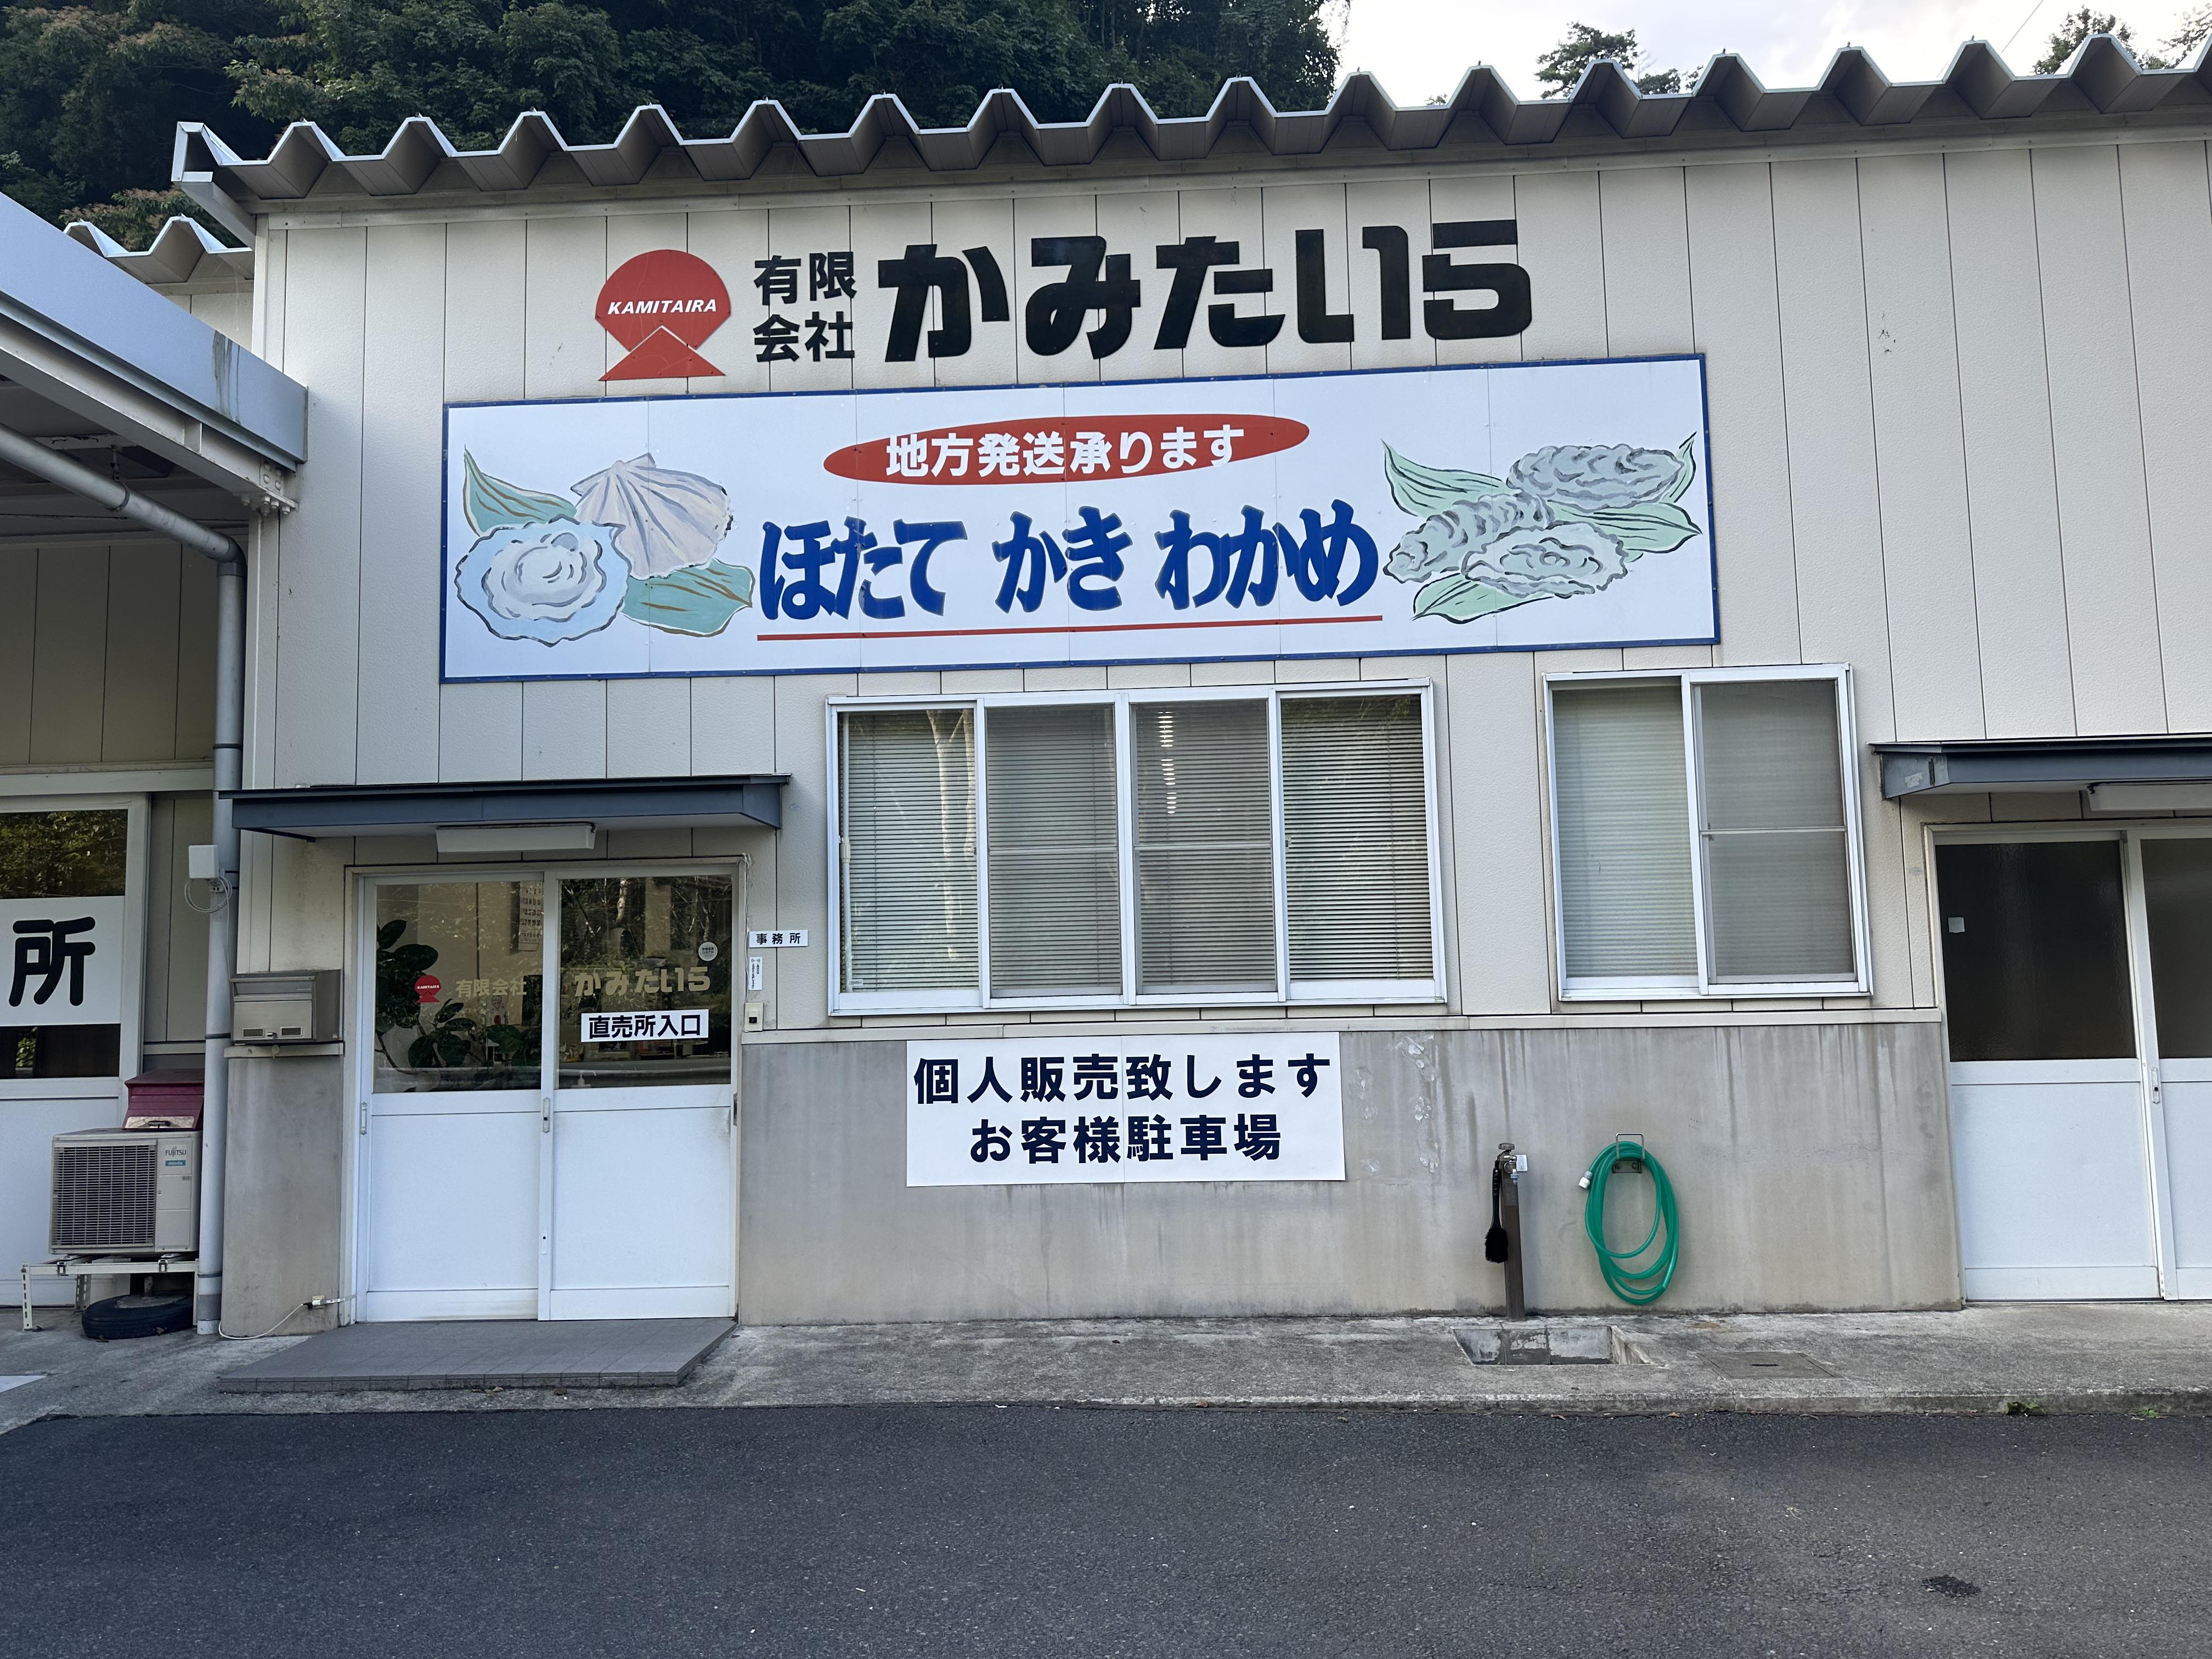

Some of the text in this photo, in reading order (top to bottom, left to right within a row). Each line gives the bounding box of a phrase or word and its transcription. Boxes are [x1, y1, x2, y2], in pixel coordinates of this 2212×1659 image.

[753, 251, 856, 306] 有限
[878, 219, 1533, 363] かみたいら
[607, 298, 716, 315] KAMITAIRA
[753, 311, 855, 363] 会社
[884, 424, 1245, 478] 地方発送承ります
[759, 499, 1379, 620] ほたて かき わかめ
[9, 917, 96, 1007] 所
[756, 933, 801, 945] 事務所
[456, 966, 711, 998] 有限会社 かみたいら
[588, 1014, 701, 1040] 直売所入口
[913, 1053, 1331, 1104] 個人販売致します
[165, 1147, 187, 1157] FUJITSU
[969, 1113, 1281, 1165] お客様駐車場
